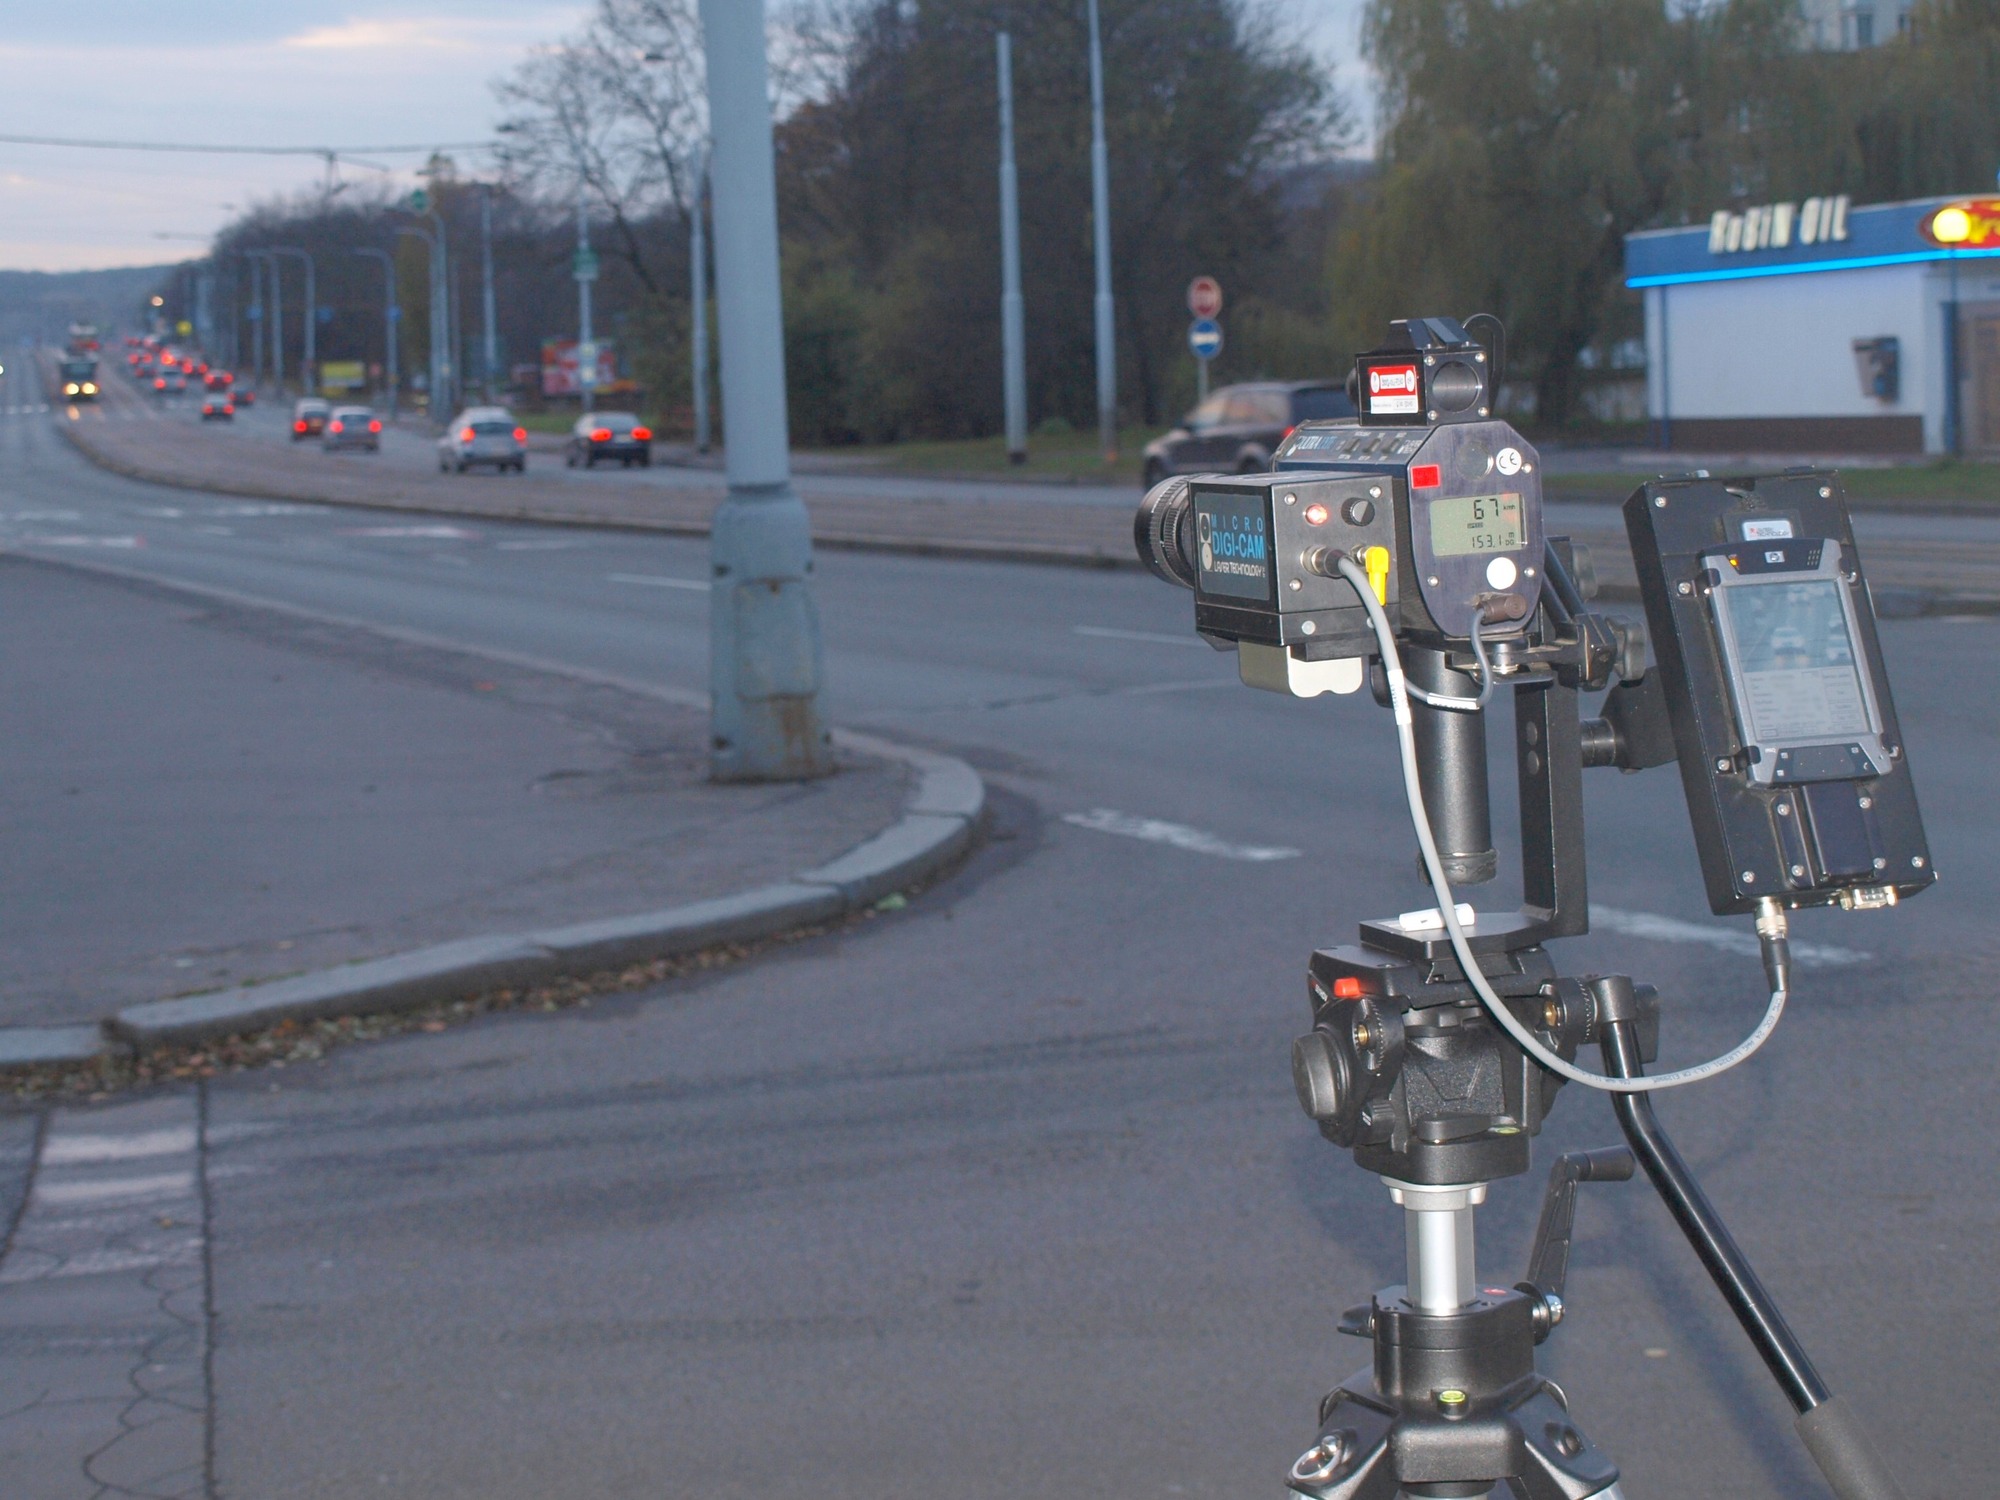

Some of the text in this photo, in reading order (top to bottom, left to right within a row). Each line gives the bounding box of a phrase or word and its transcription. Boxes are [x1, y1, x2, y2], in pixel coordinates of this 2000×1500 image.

[1800, 194, 1848, 246] OIL
[1473, 498, 1499, 520] 67
[1211, 513, 1264, 533] MICRO
[1212, 531, 1265, 560] DIGI-CAM
[1472, 535, 1502, 549] 153.1
[1229, 561, 1262, 577] TECHNOLOGY
